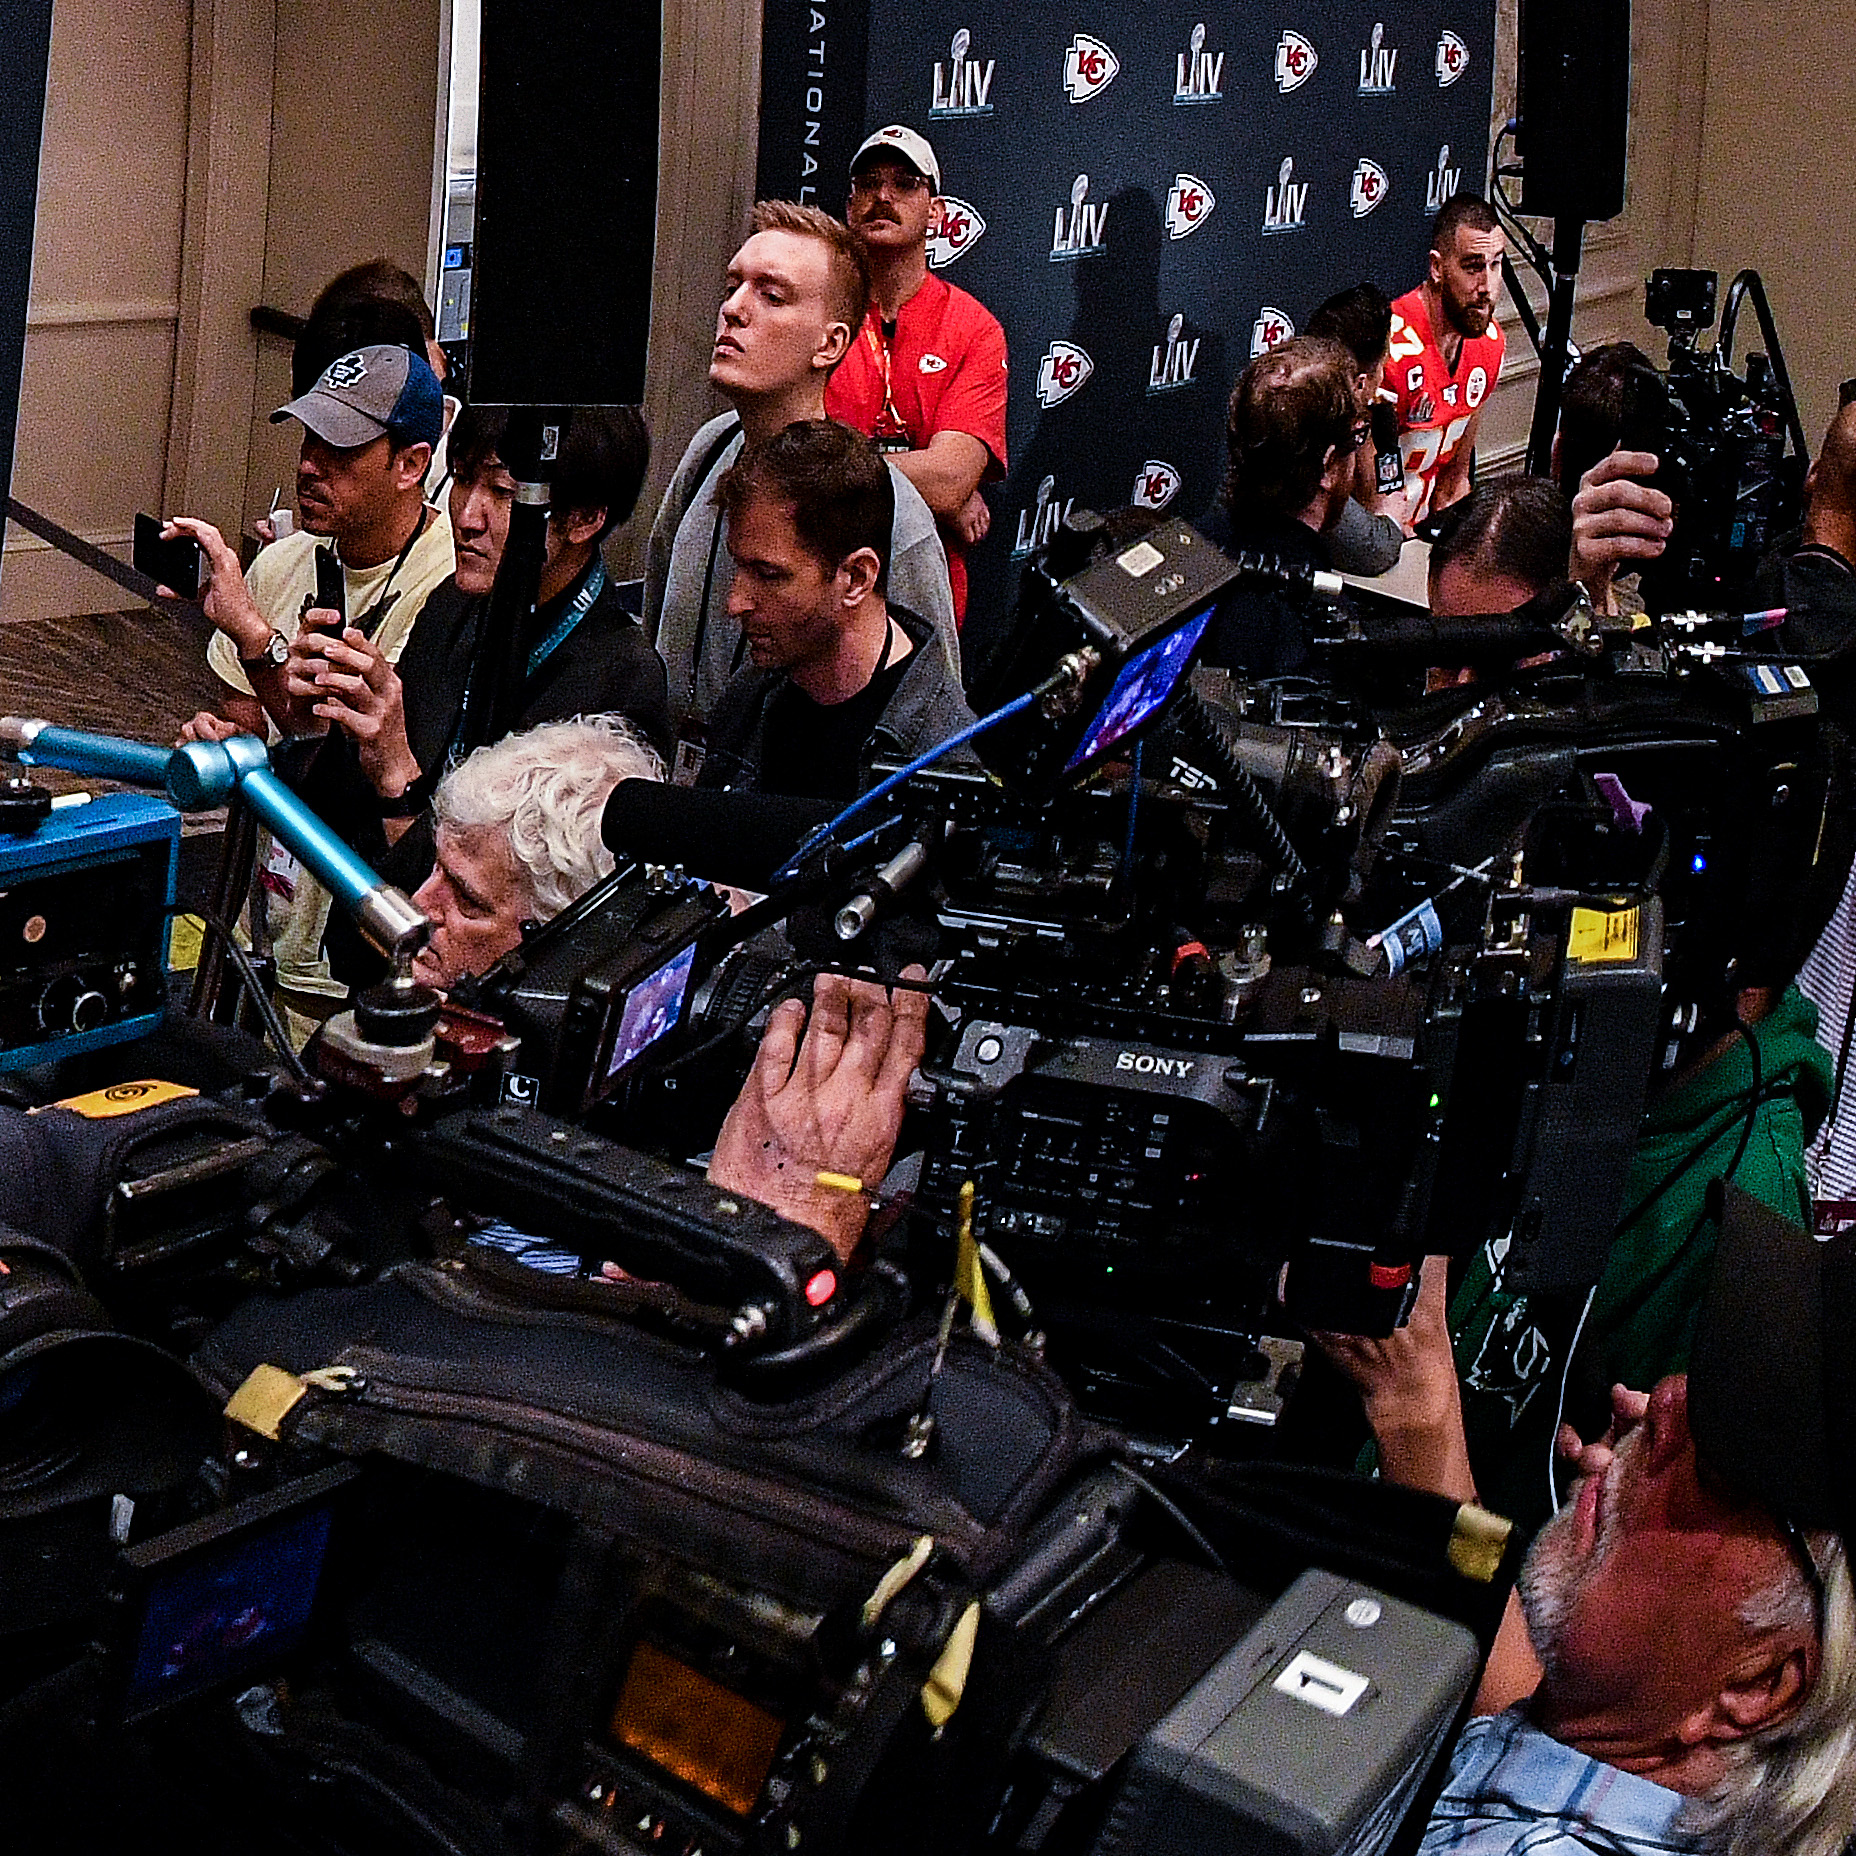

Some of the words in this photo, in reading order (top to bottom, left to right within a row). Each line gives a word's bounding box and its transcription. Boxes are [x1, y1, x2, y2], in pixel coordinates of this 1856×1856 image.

[933, 60, 995, 108] LIV
[1077, 50, 1106, 85] KC
[1177, 52, 1224, 94] LIV
[1360, 49, 1397, 87] LIV
[1265, 183, 1308, 226] LIV
[941, 211, 970, 248] KC
[1053, 202, 1109, 250] LIV
[1052, 354, 1080, 389] KC
[1149, 338, 1200, 386] LIV
[573, 588, 593, 612] LIV
[1116, 1052, 1193, 1079] SONY
